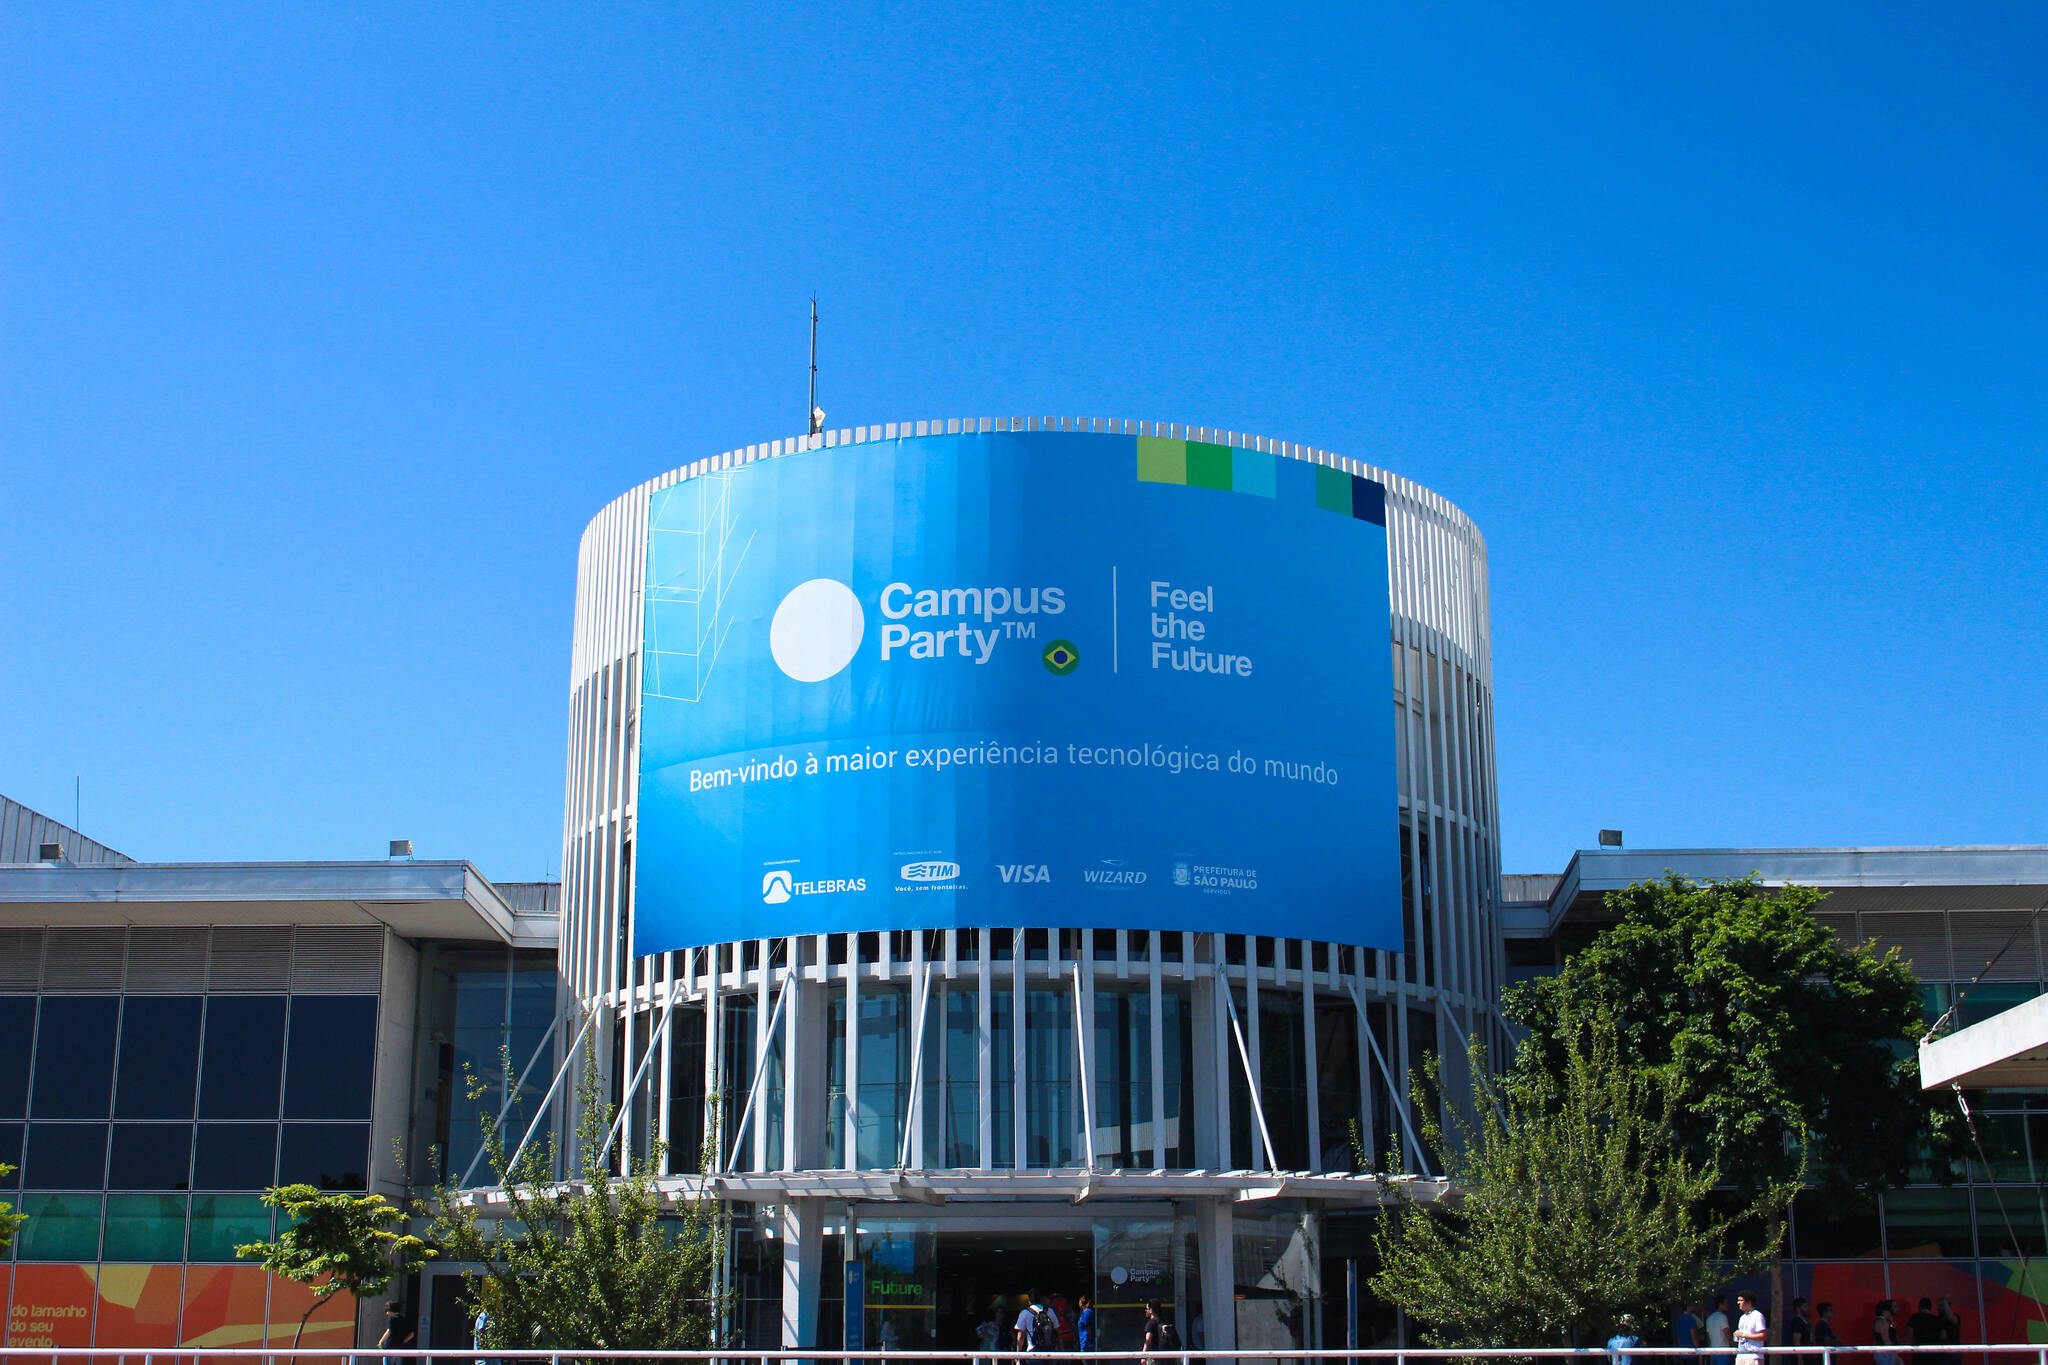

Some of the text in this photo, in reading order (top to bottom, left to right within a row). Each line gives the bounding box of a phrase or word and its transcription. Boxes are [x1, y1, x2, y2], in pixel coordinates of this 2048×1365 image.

[880, 582, 1066, 622] Campus
[1150, 581, 1214, 612] Feel
[1152, 612, 1205, 641] the
[1151, 642, 1253, 677] Future
[690, 741, 1338, 792] Bem-vindo à maior experiência tecnológica do mundo
[928, 864, 954, 877] TIM
[995, 864, 1051, 883] VISA
[1083, 870, 1147, 884] WIZARD
[1193, 865, 1257, 878] PREFEITURA DE
[793, 879, 867, 895] TELEBRAS
[1193, 874, 1258, 890] SÃO PAULO
[871, 1280, 922, 1295] Future
[12, 1304, 28, 1317] do
[10, 1320, 54, 1332] do seu
[8, 1335, 53, 1348] evento
